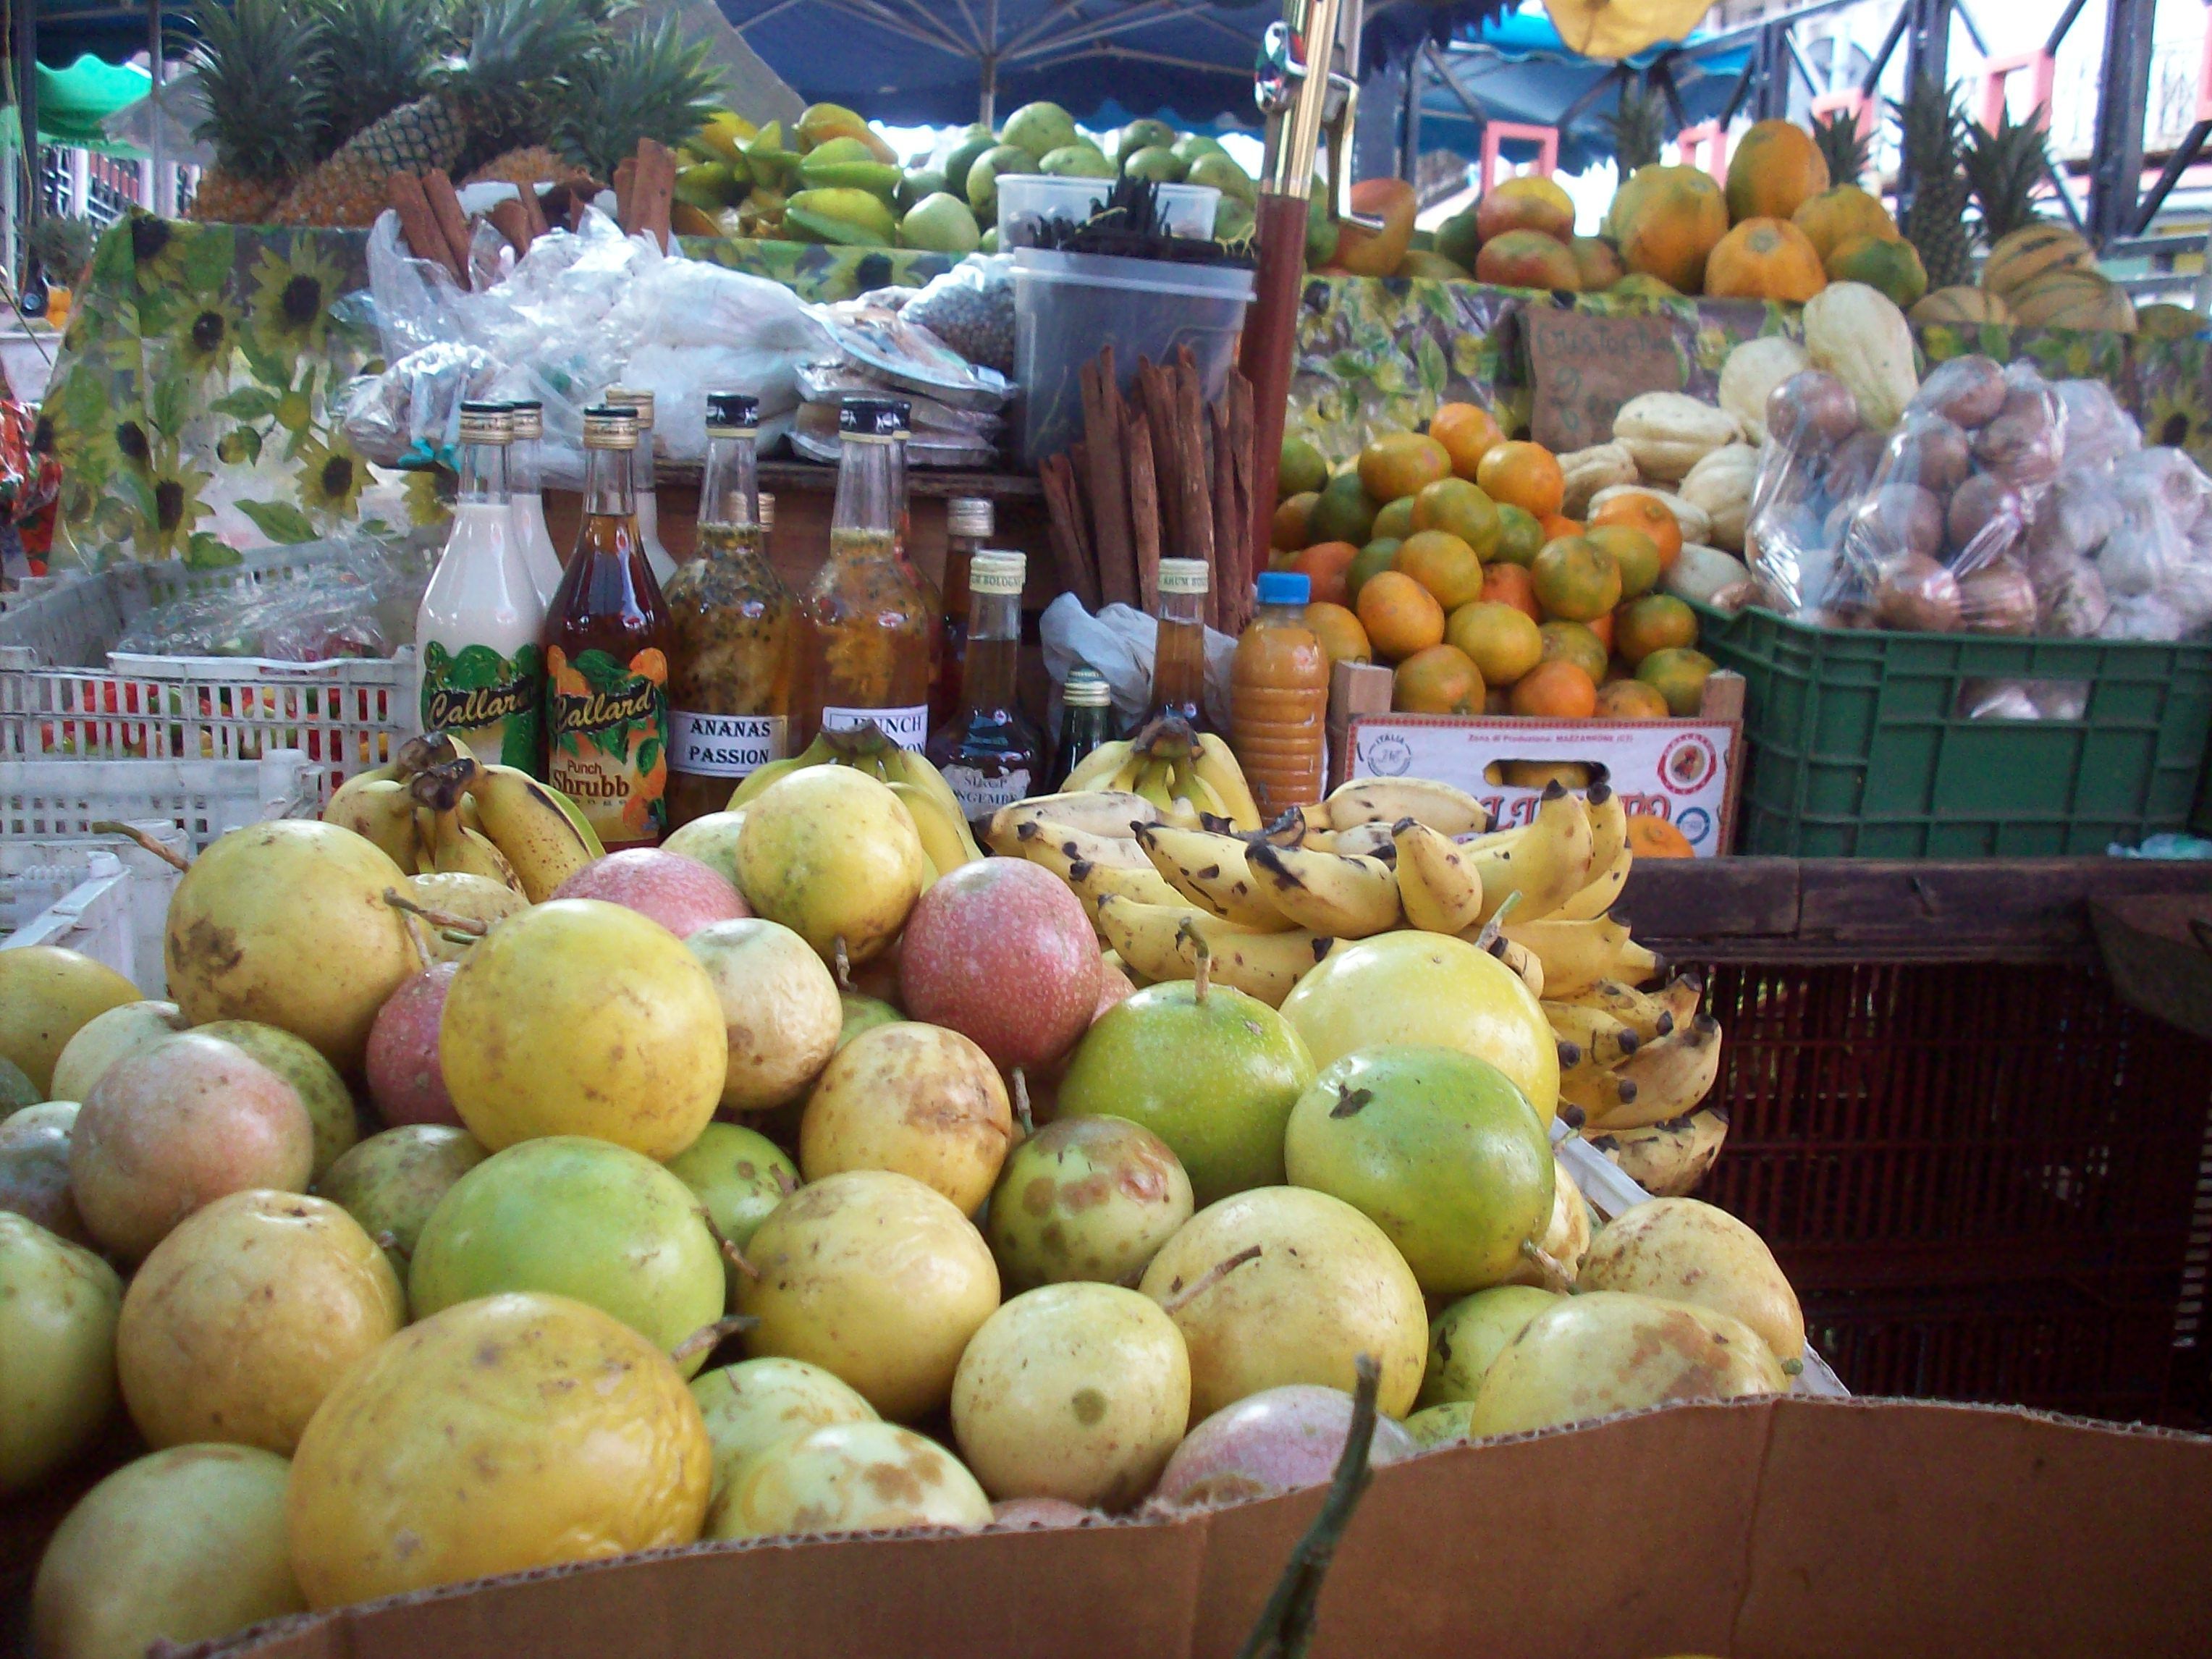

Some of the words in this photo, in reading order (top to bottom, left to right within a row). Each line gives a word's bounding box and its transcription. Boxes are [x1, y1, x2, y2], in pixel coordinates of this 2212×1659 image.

[690, 718, 771, 738] ANANAS
[1375, 734, 1405, 746] ITALIA
[689, 746, 770, 765] PASSION
[567, 759, 603, 775] Punch
[553, 769, 630, 798] Shrubb
